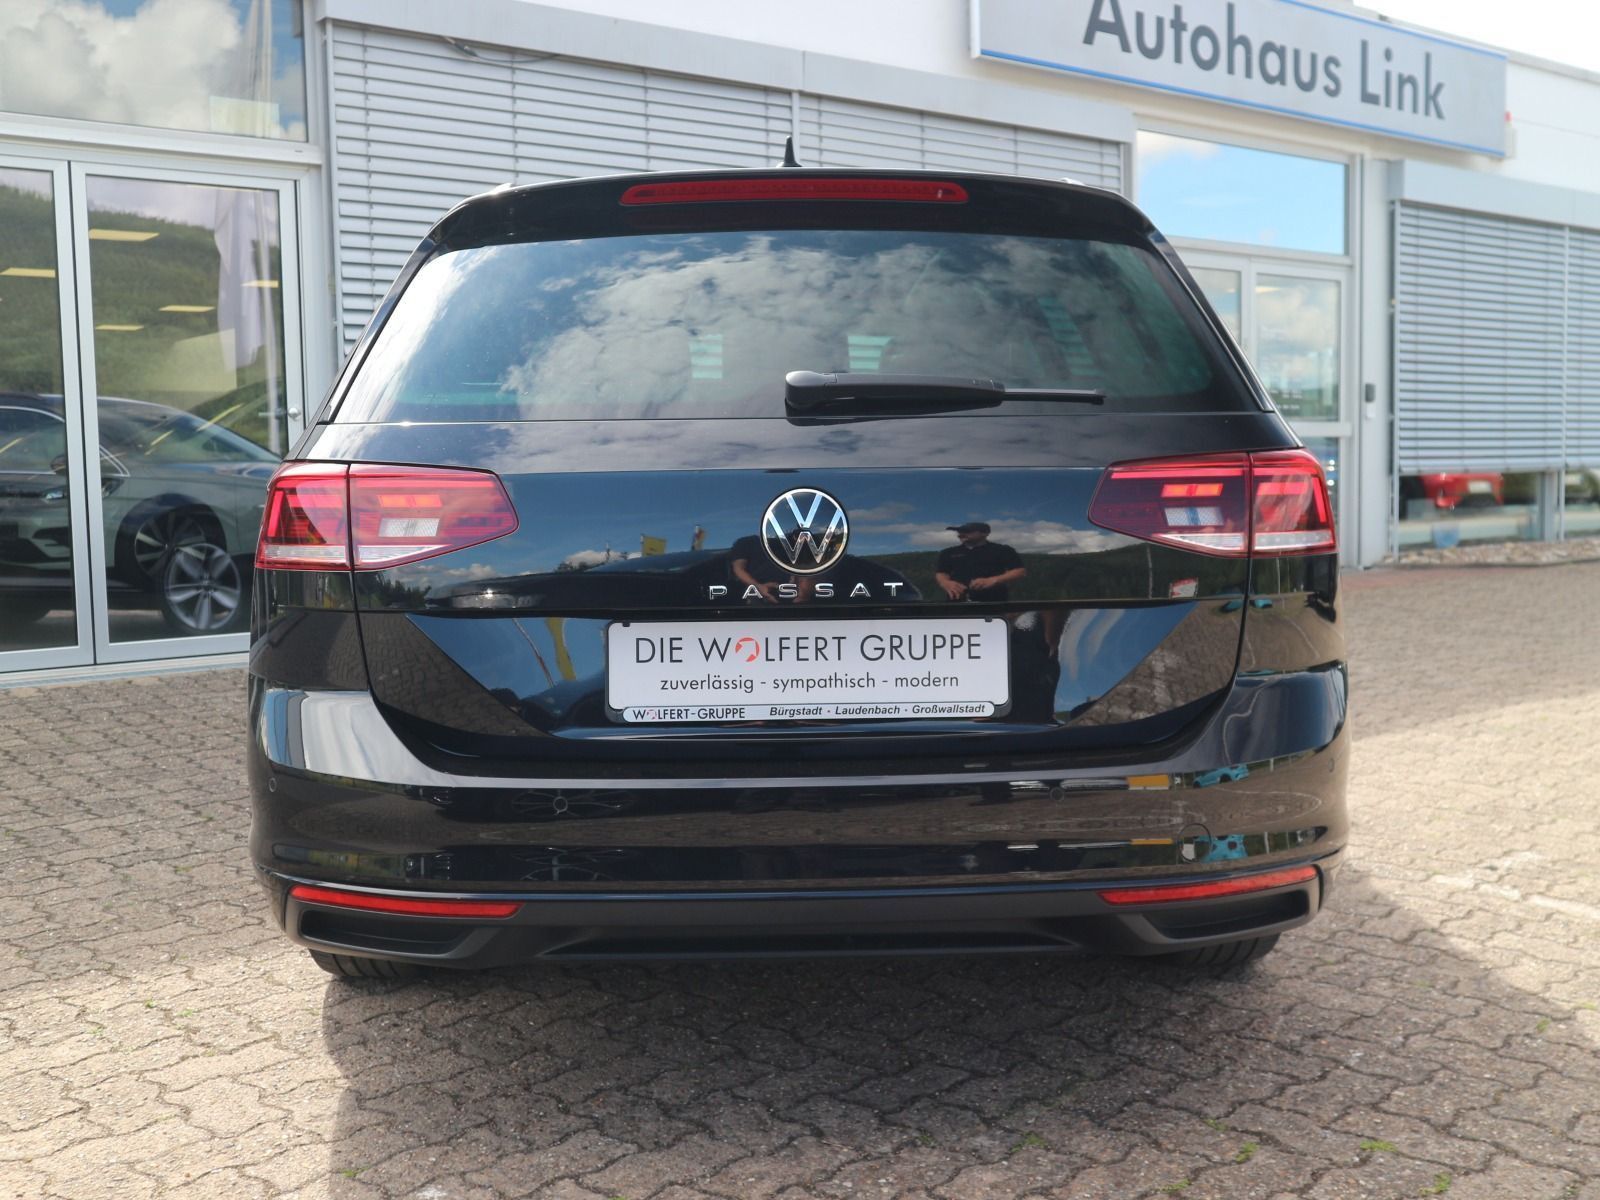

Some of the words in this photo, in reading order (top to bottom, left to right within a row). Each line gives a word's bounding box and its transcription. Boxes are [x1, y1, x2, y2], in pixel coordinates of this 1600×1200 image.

[1082, 0, 1342, 98] Autohaus
[1359, 39, 1446, 121] Link
[763, 489, 848, 573] VW
[708, 582, 903, 600] PASSAT
[635, 637, 683, 663] DIE
[698, 635, 847, 663] WOLFERT
[860, 633, 982, 661] GRUPPE
[660, 673, 754, 694] zuverlässig
[772, 671, 876, 693] sympathisch
[894, 671, 959, 688] modern
[769, 705, 823, 717] Bürgstadt
[834, 704, 900, 716] Laudenbach
[911, 704, 986, 716] Großwallstadt
